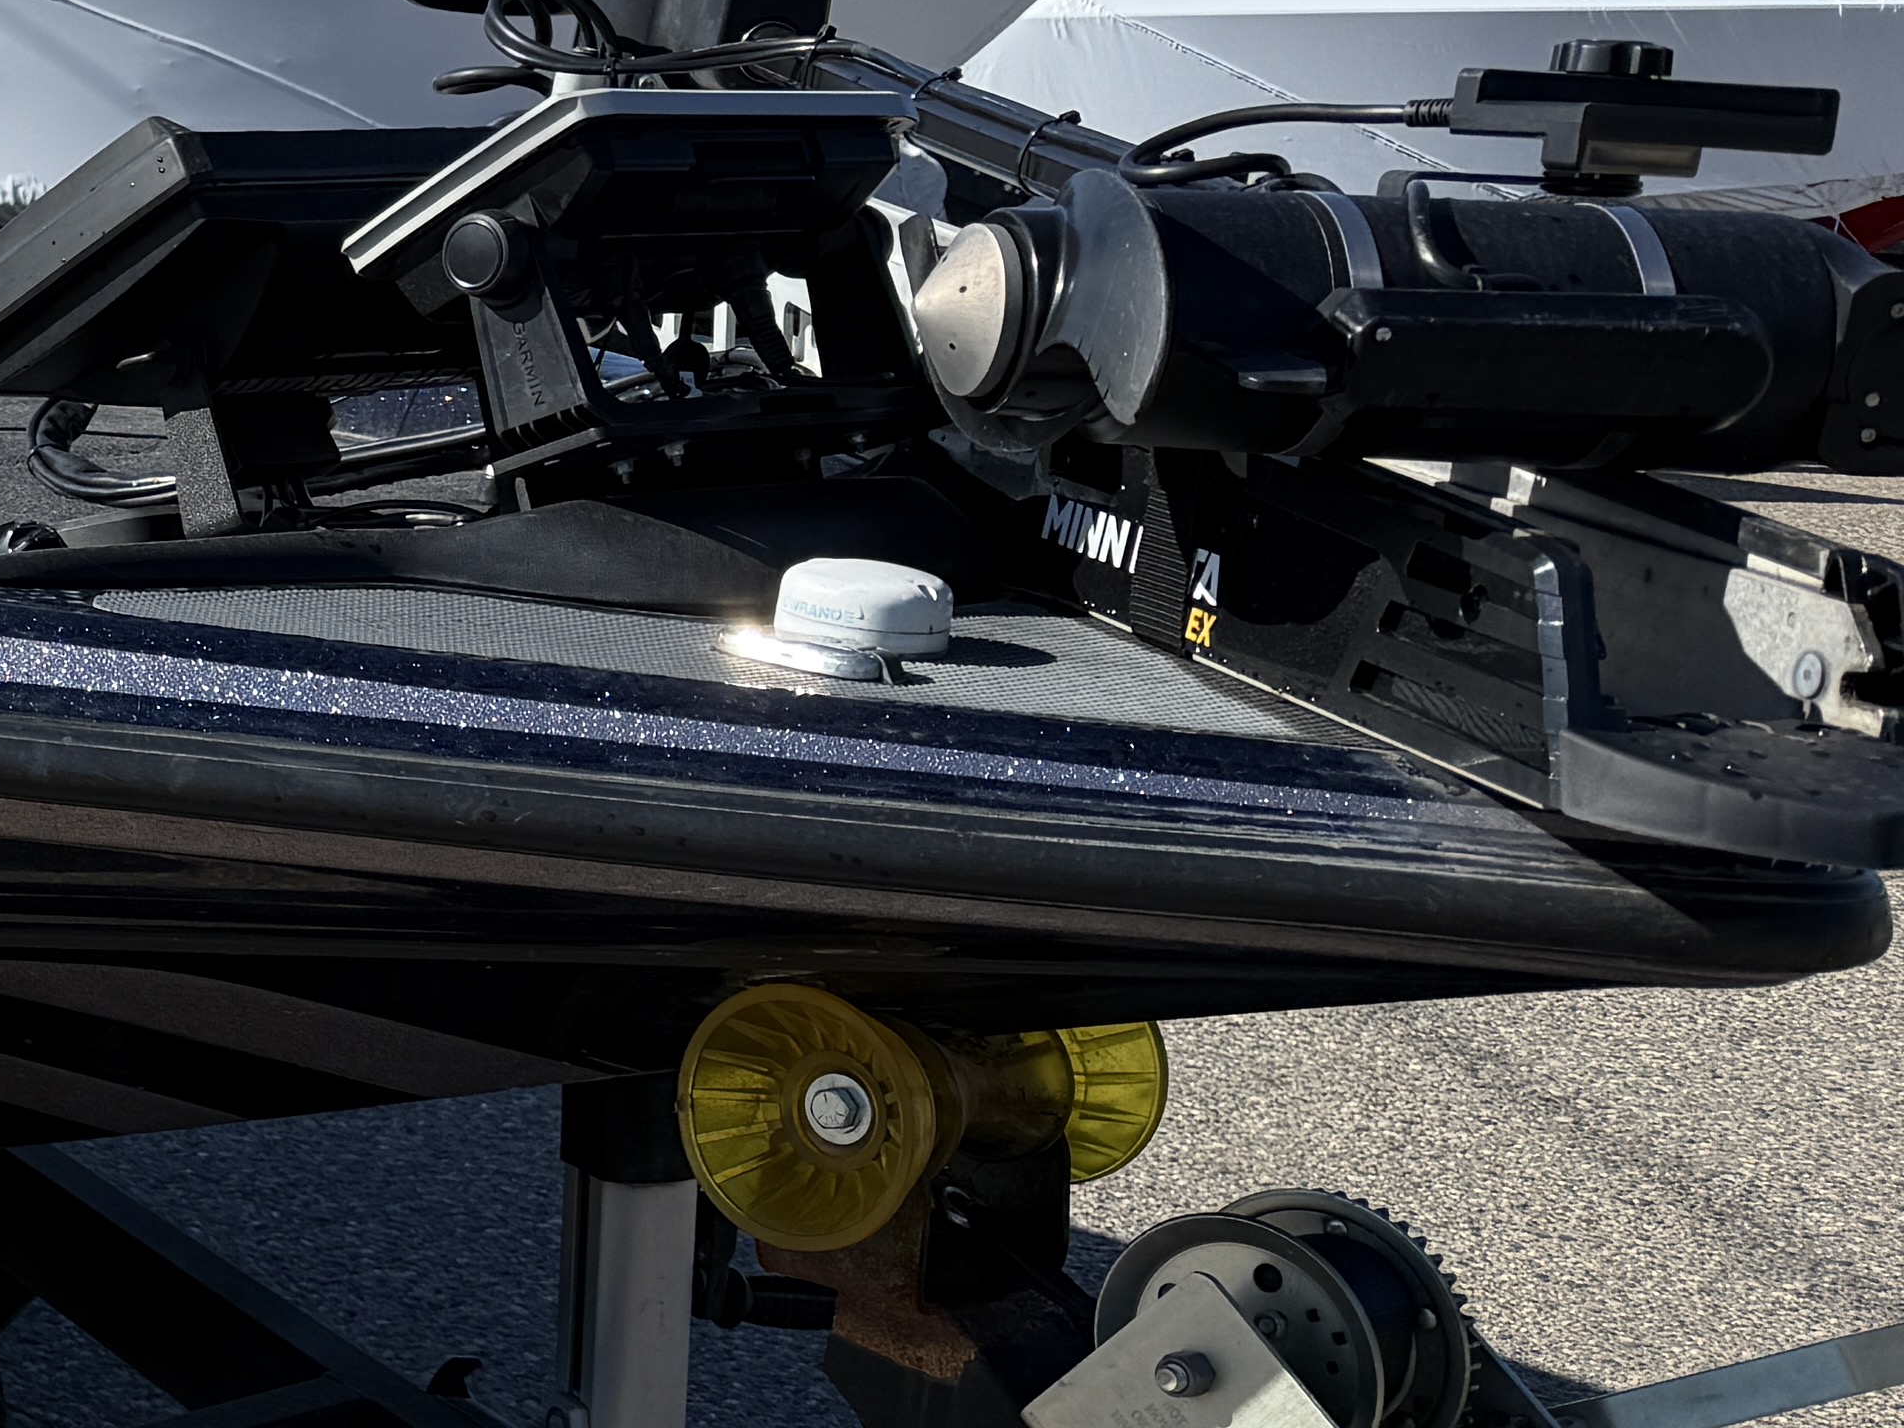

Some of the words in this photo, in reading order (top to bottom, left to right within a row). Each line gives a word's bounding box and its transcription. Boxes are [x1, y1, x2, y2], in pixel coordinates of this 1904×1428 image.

[513, 321, 546, 408] GARMIN
[1041, 493, 1132, 569] MINN
[1184, 607, 1217, 648] EX
